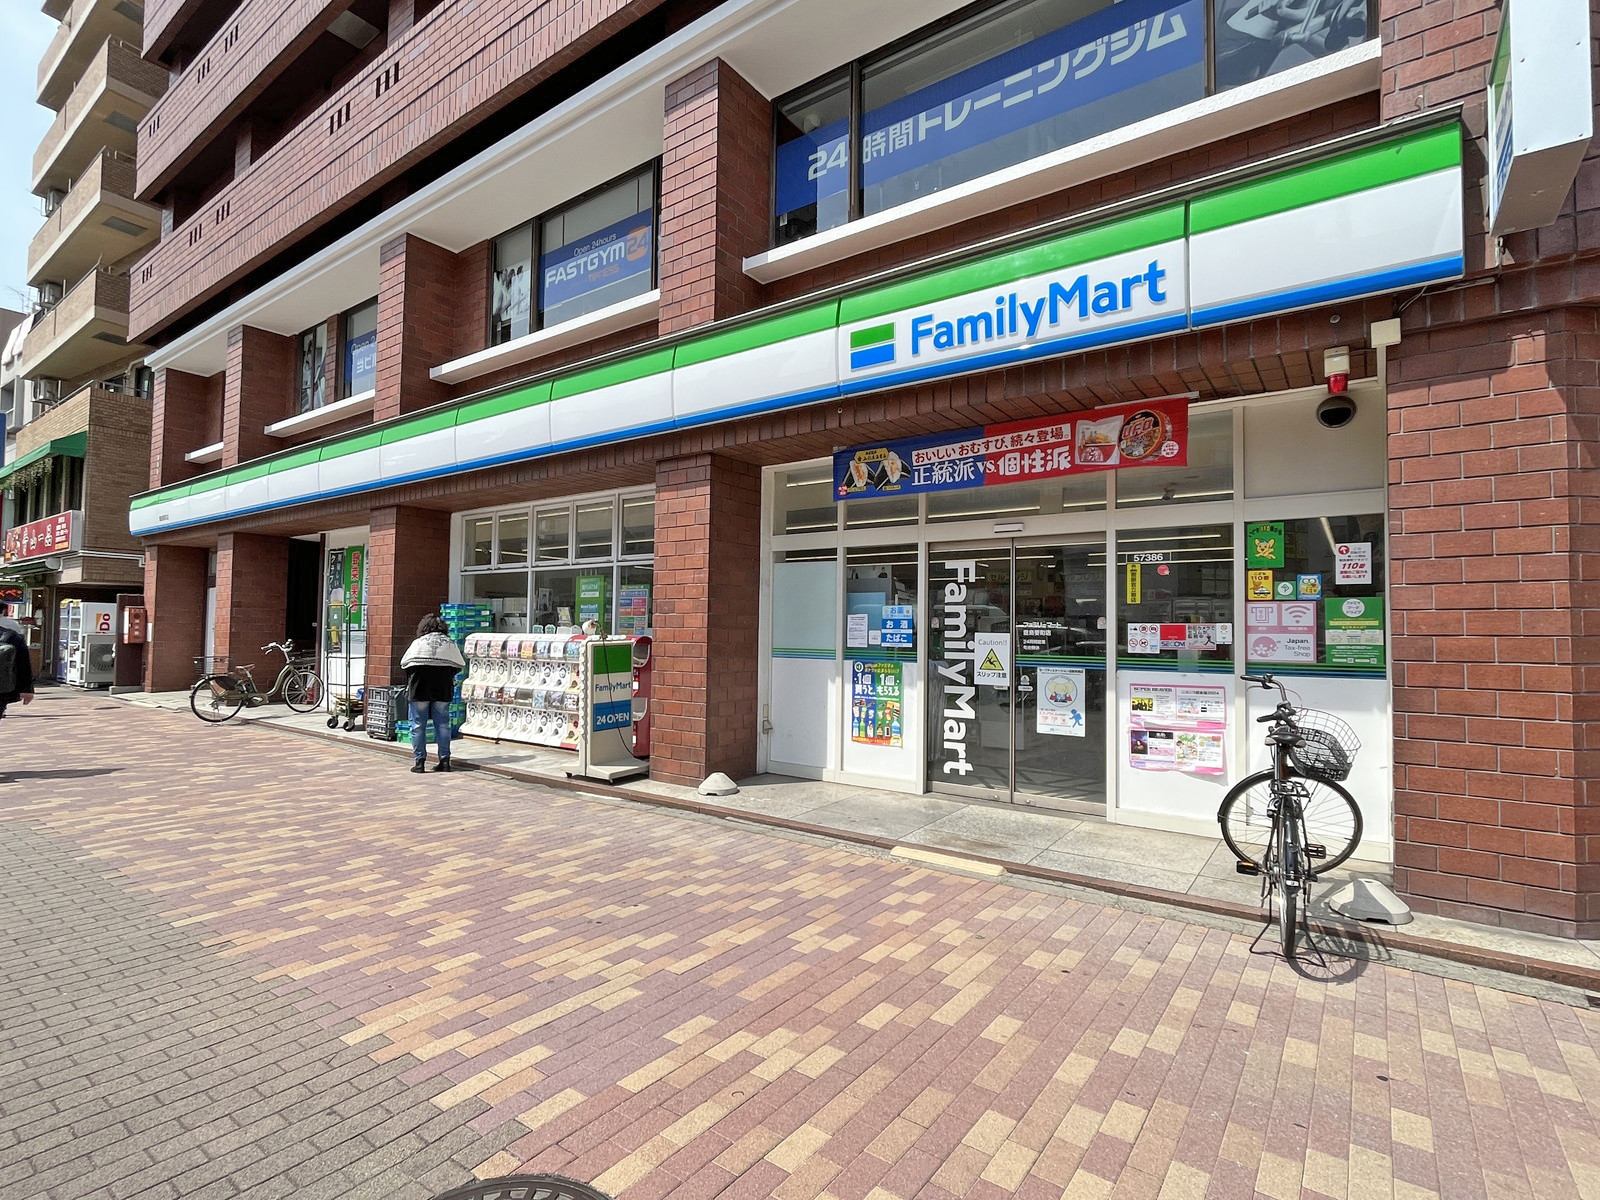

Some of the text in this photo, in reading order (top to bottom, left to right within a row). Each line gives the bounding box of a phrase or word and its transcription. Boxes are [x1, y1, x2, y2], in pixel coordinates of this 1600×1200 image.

[807, 11, 1188, 181] 24時間トレーニングジム
[545, 241, 625, 288] FASTGYM
[573, 233, 617, 257] Open 24hours
[911, 259, 1166, 356] FamilyMart
[914, 447, 956, 464] おいしい
[958, 427, 1070, 457] おむすび、続々登場。
[911, 458, 976, 487] 正統派
[997, 445, 1072, 476] 個性派
[1133, 553, 1164, 562] 57386
[886, 634, 908, 642] たばこ
[938, 560, 976, 776] FamilyMart
[976, 671, 1008, 679] スリップ注意
